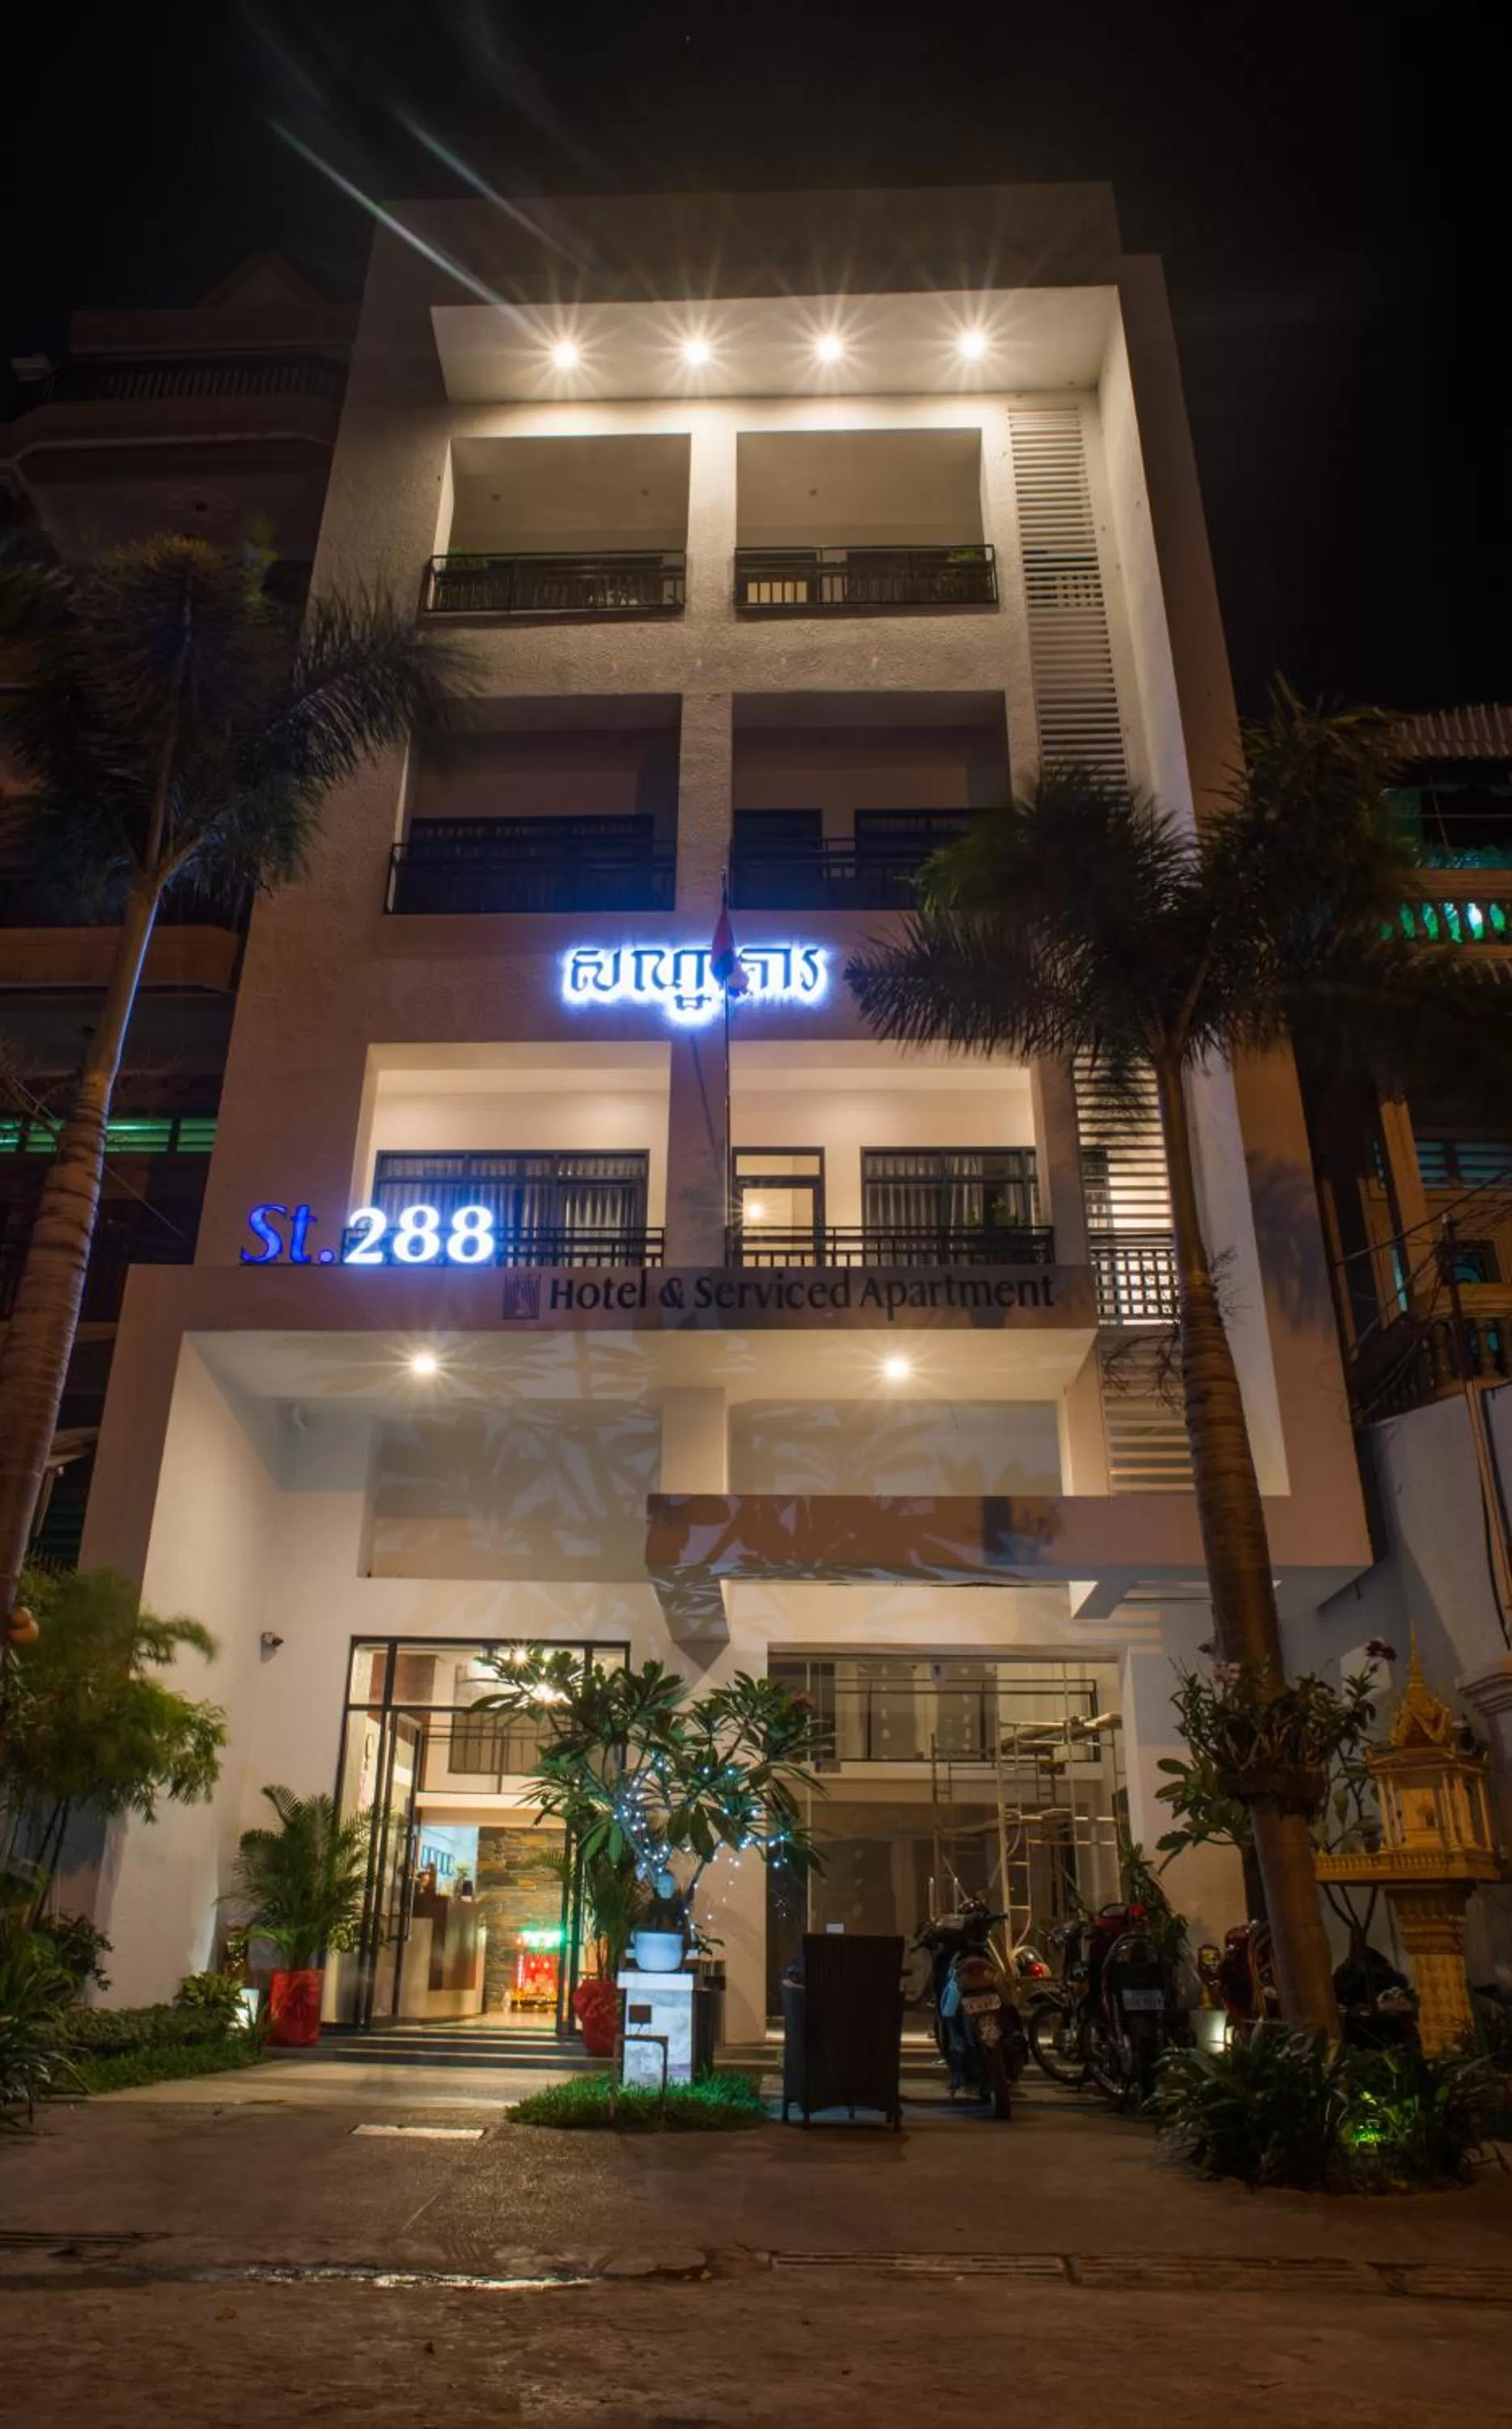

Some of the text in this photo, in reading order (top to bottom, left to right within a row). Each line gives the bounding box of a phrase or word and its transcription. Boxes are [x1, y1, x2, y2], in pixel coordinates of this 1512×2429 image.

[568, 946, 822, 1013] សណ្ឋគារ
[550, 1268, 1056, 1322] Hotel & Serviced Apartment
